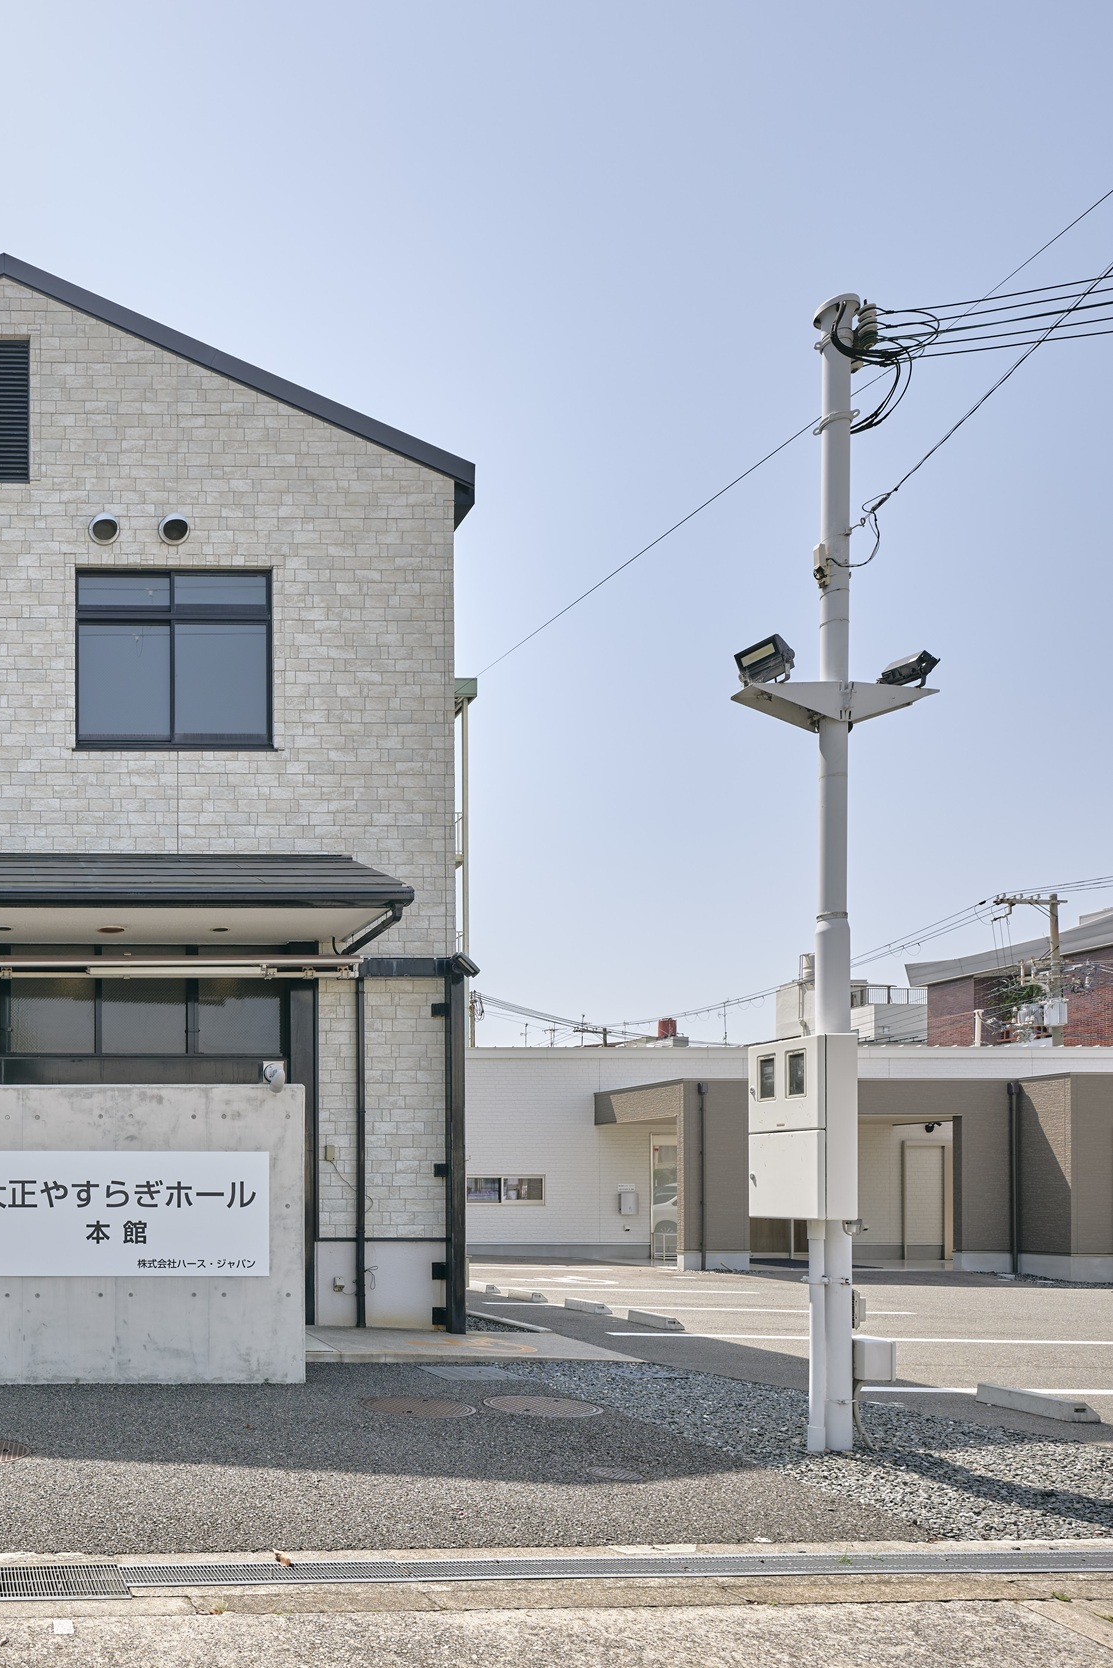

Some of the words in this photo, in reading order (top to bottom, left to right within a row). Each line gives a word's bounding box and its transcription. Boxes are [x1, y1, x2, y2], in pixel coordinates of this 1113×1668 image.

[85, 1219, 148, 1245] 本館
[136, 1258, 256, 1269] 株式会社ハース・ジャパン
